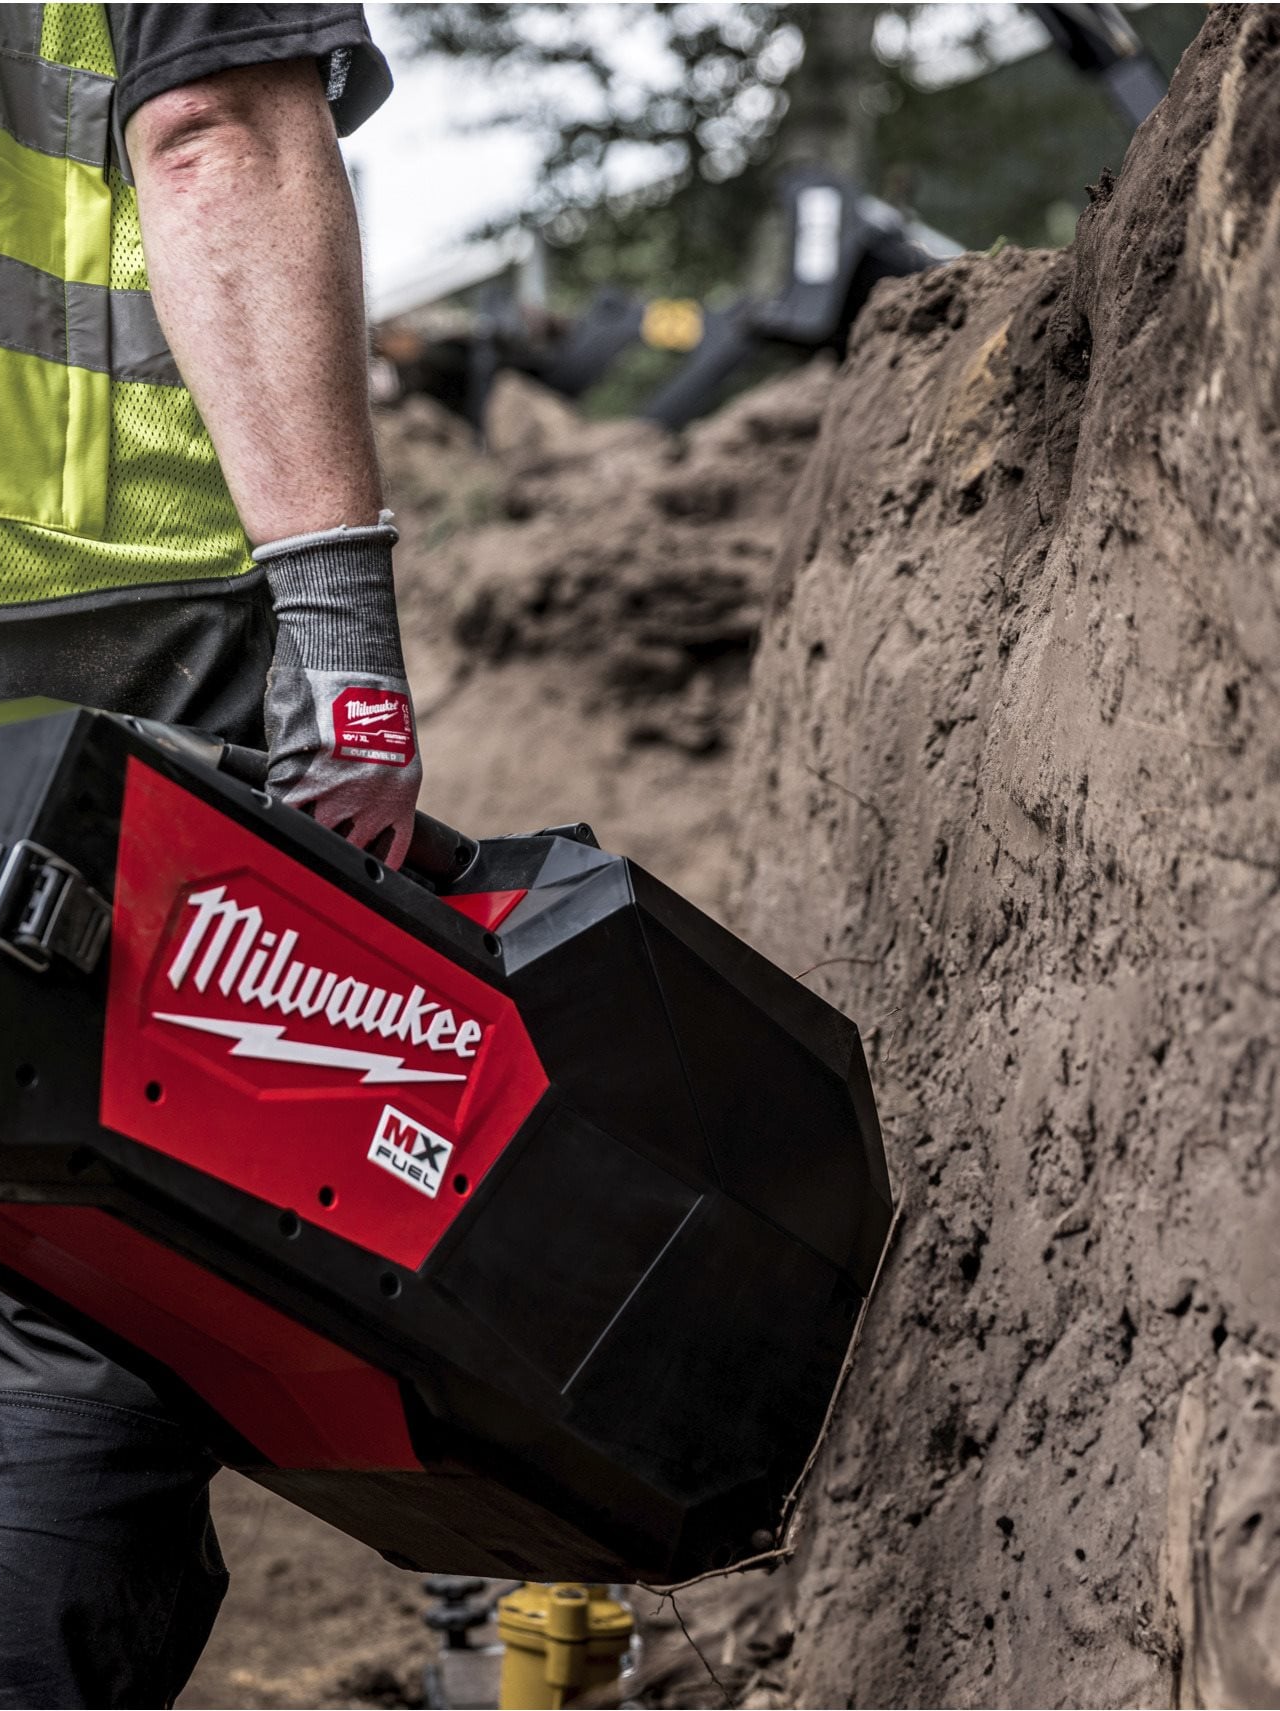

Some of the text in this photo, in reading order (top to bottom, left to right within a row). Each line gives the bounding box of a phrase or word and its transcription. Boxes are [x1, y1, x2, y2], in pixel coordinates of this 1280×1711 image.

[345, 699, 399, 720] Milwaukee
[350, 748, 367, 757] CUT
[367, 750, 389, 760] LEVEL
[166, 885, 482, 1058] Milwaukee
[380, 1113, 447, 1173] MX
[375, 1144, 435, 1191] FUEL
